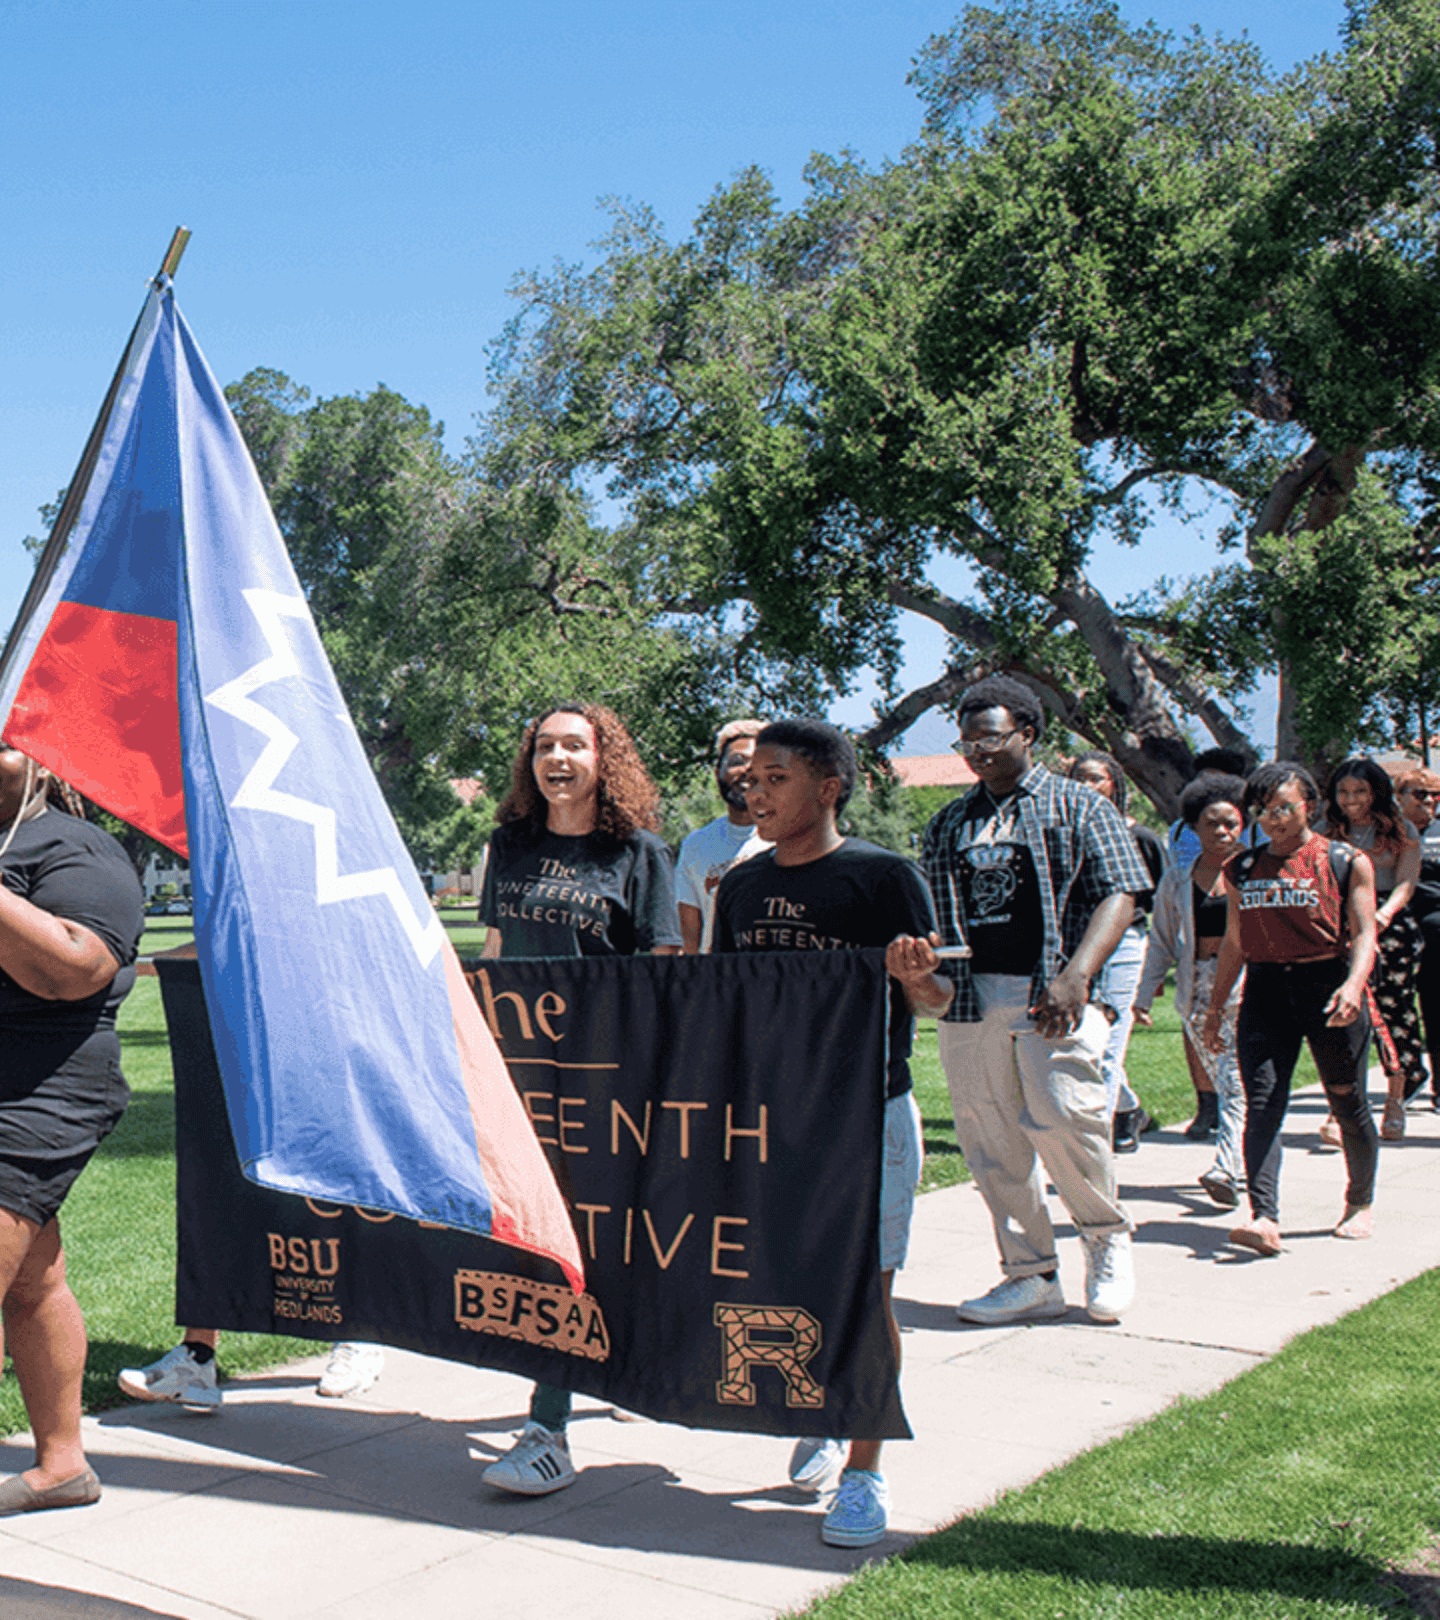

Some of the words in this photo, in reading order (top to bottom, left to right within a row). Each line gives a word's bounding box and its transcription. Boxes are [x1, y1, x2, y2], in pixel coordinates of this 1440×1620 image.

[539, 858, 576, 879] The
[497, 902, 604, 937] OLLECTIVE
[763, 897, 806, 919] The
[523, 1091, 768, 1164] EENTH
[267, 1232, 341, 1276] BSU
[274, 1298, 343, 1324] REDLANDS
[713, 1301, 825, 1408] R
